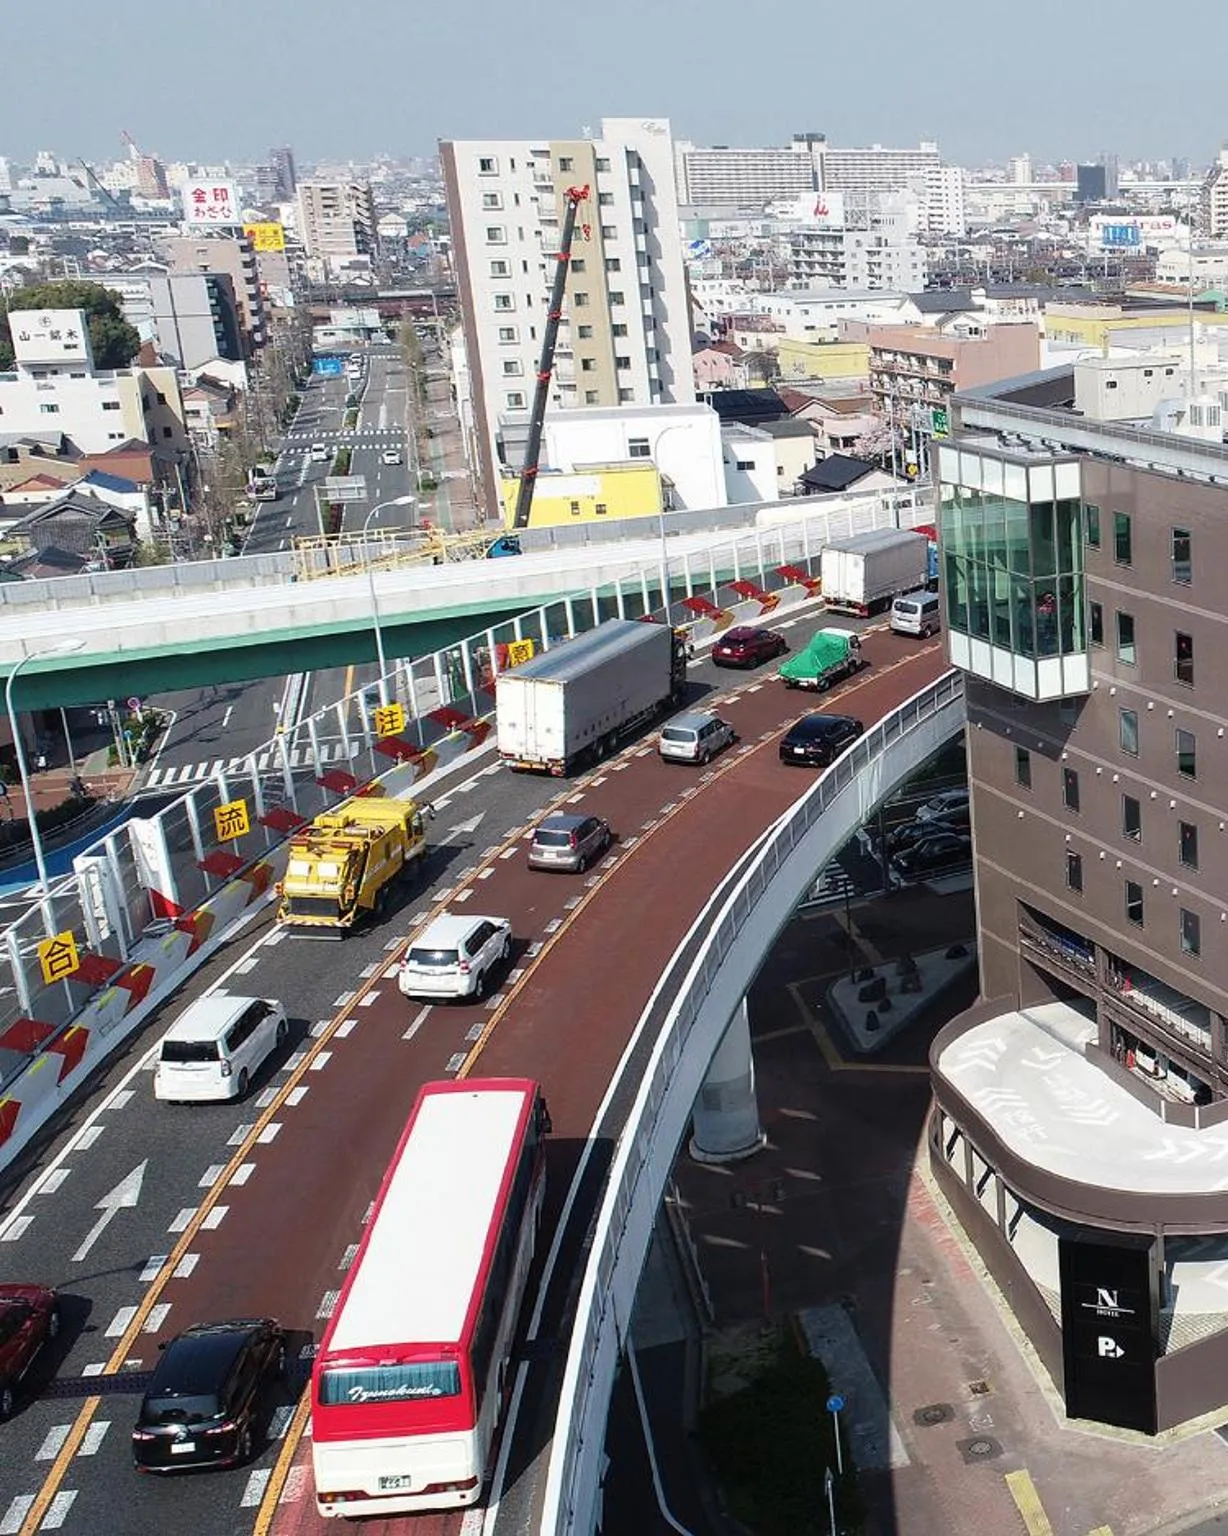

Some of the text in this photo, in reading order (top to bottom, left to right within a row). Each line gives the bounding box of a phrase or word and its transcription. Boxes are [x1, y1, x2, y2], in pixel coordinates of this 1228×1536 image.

[191, 187, 229, 204] 金印
[379, 710, 401, 734] 注
[219, 807, 245, 836] 流
[44, 941, 73, 976] 合
[1097, 1288, 1119, 1307] N
